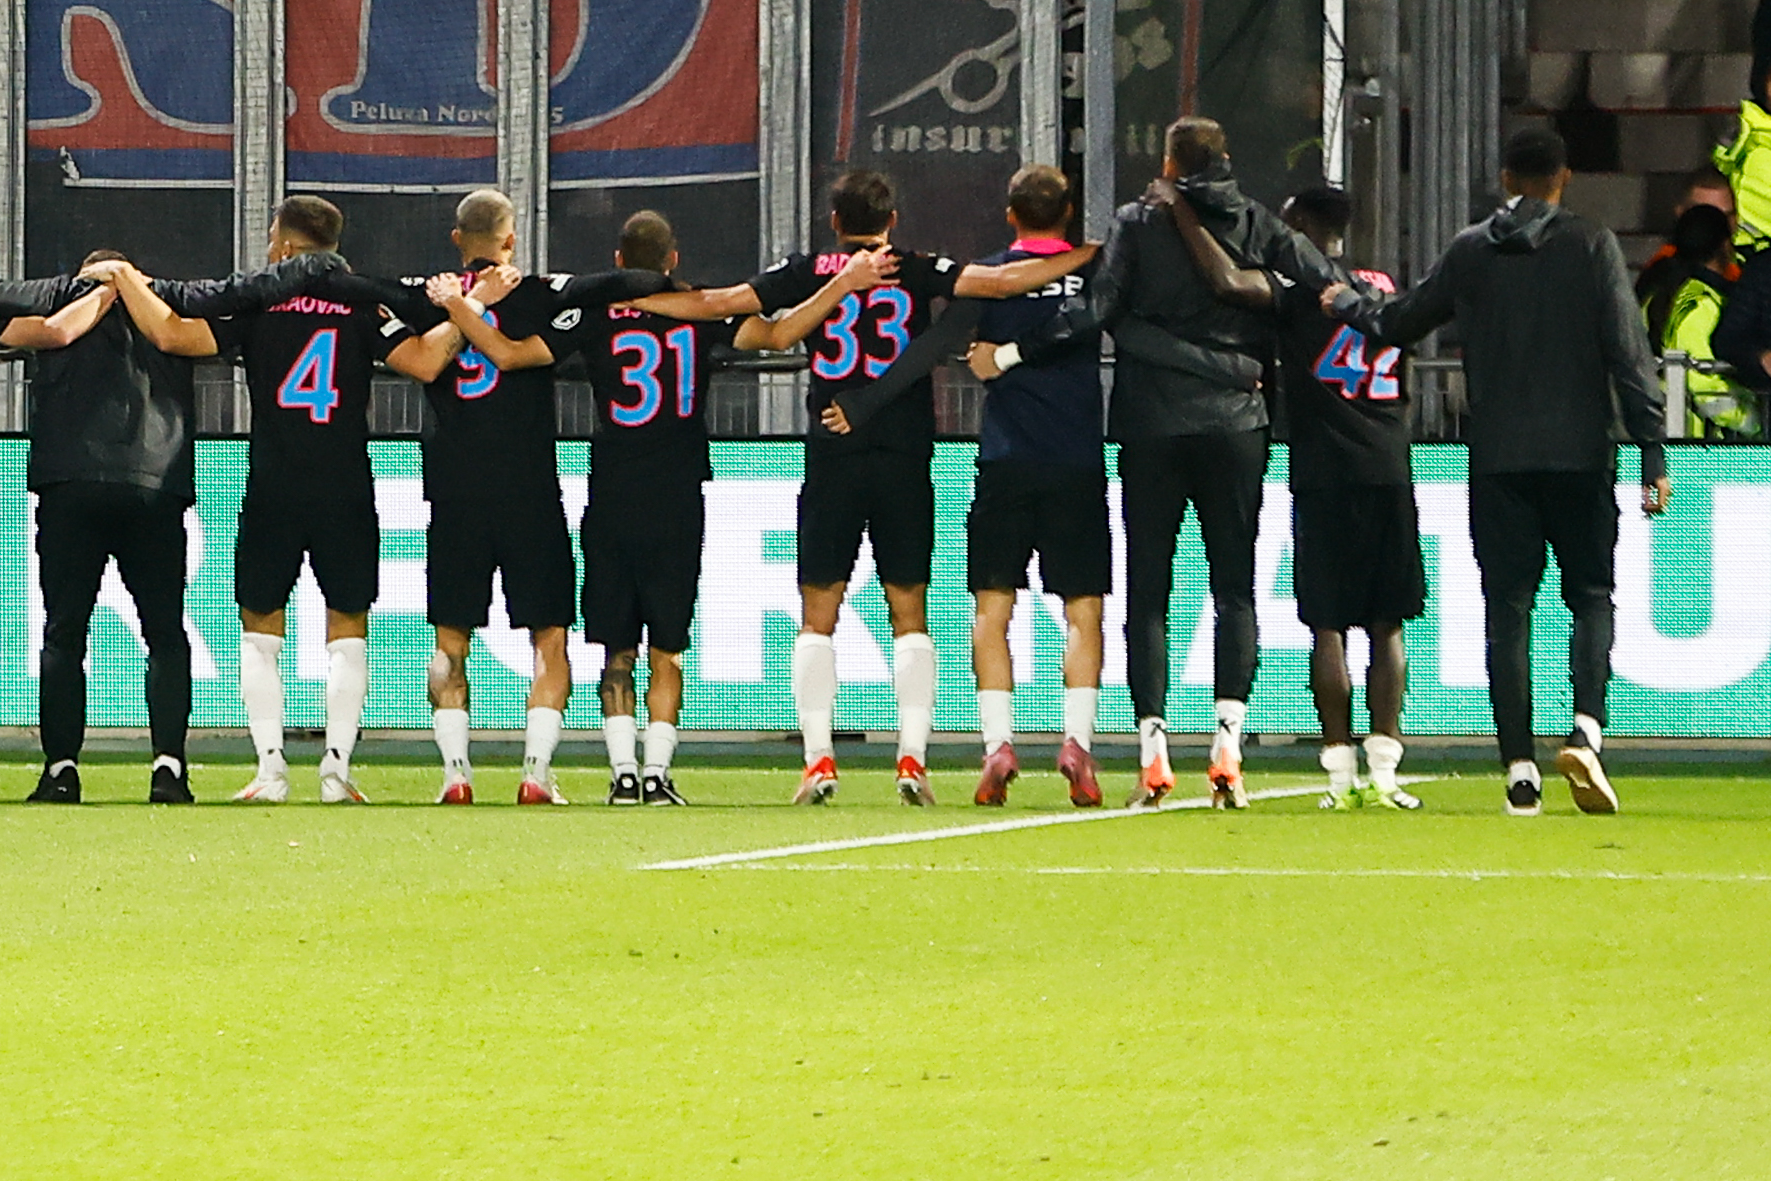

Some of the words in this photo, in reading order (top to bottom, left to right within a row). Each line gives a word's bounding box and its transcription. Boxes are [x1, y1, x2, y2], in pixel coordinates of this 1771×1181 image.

[276, 327, 341, 424] 4
[609, 323, 696, 428] 31
[811, 284, 914, 381] 33
